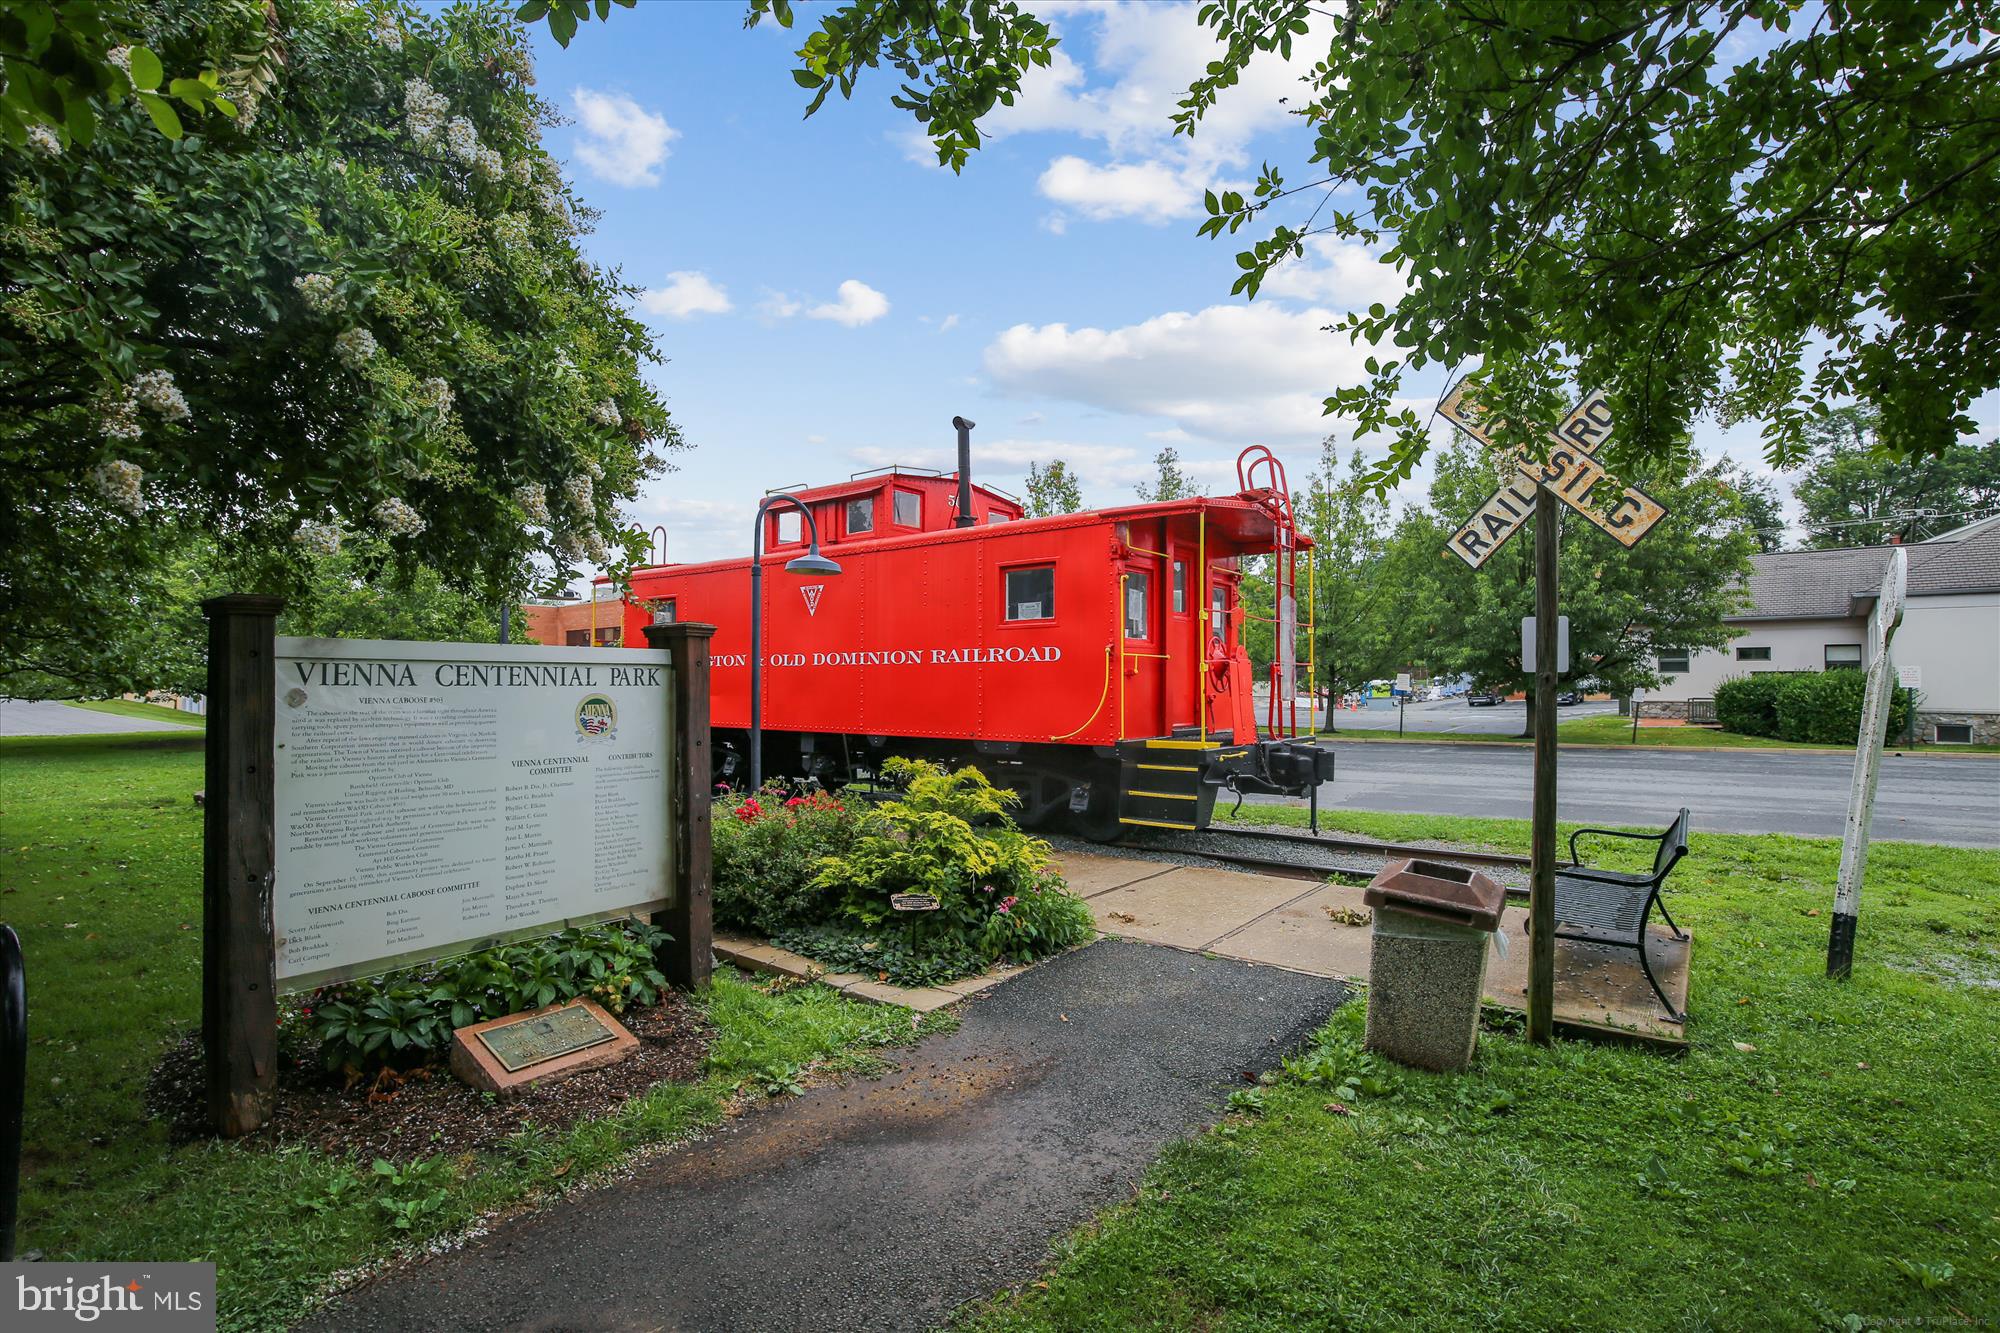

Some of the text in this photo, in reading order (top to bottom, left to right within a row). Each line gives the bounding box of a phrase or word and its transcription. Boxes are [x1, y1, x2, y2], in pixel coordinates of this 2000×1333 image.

[1563, 399, 1613, 449] RO
[1457, 487, 1538, 560] RAIL
[770, 654, 807, 667] OLD
[812, 649, 924, 666] DOMINION
[930, 646, 1062, 664] RAILROAD
[294, 662, 661, 688] VIENNA CENTENNIAL PARK
[584, 704, 611, 718] VIENNA
[511, 755, 589, 767] VIENNA CENTENNIAL
[608, 752, 652, 760] CONTRIBUTORS
[529, 765, 572, 775] COMMITTEE
[308, 881, 479, 915] VIENNA CENTENNIAL CABOOSE COMMITTEE
